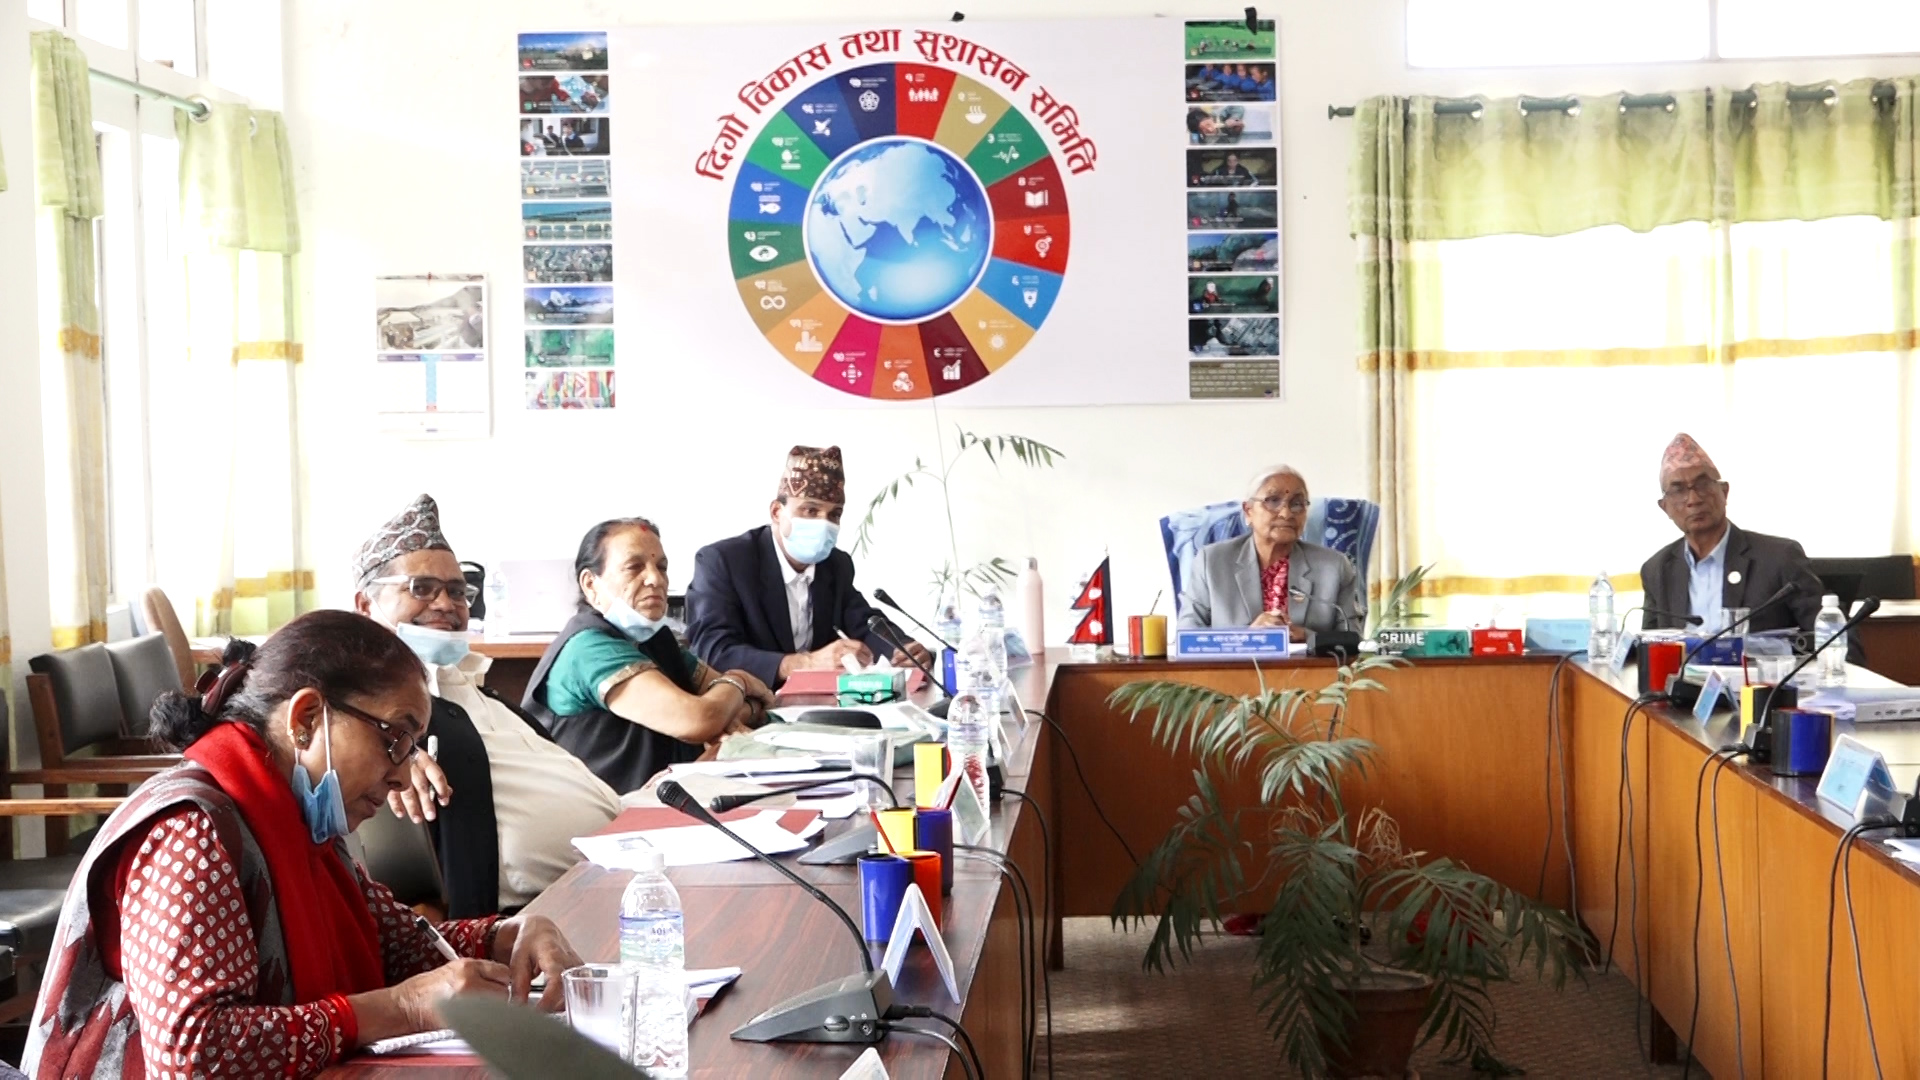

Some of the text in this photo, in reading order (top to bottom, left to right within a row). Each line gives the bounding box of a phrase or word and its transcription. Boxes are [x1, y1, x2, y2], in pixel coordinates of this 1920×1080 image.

[695, 29, 1097, 181] दिगो विकास तथा सुशासन समिति
